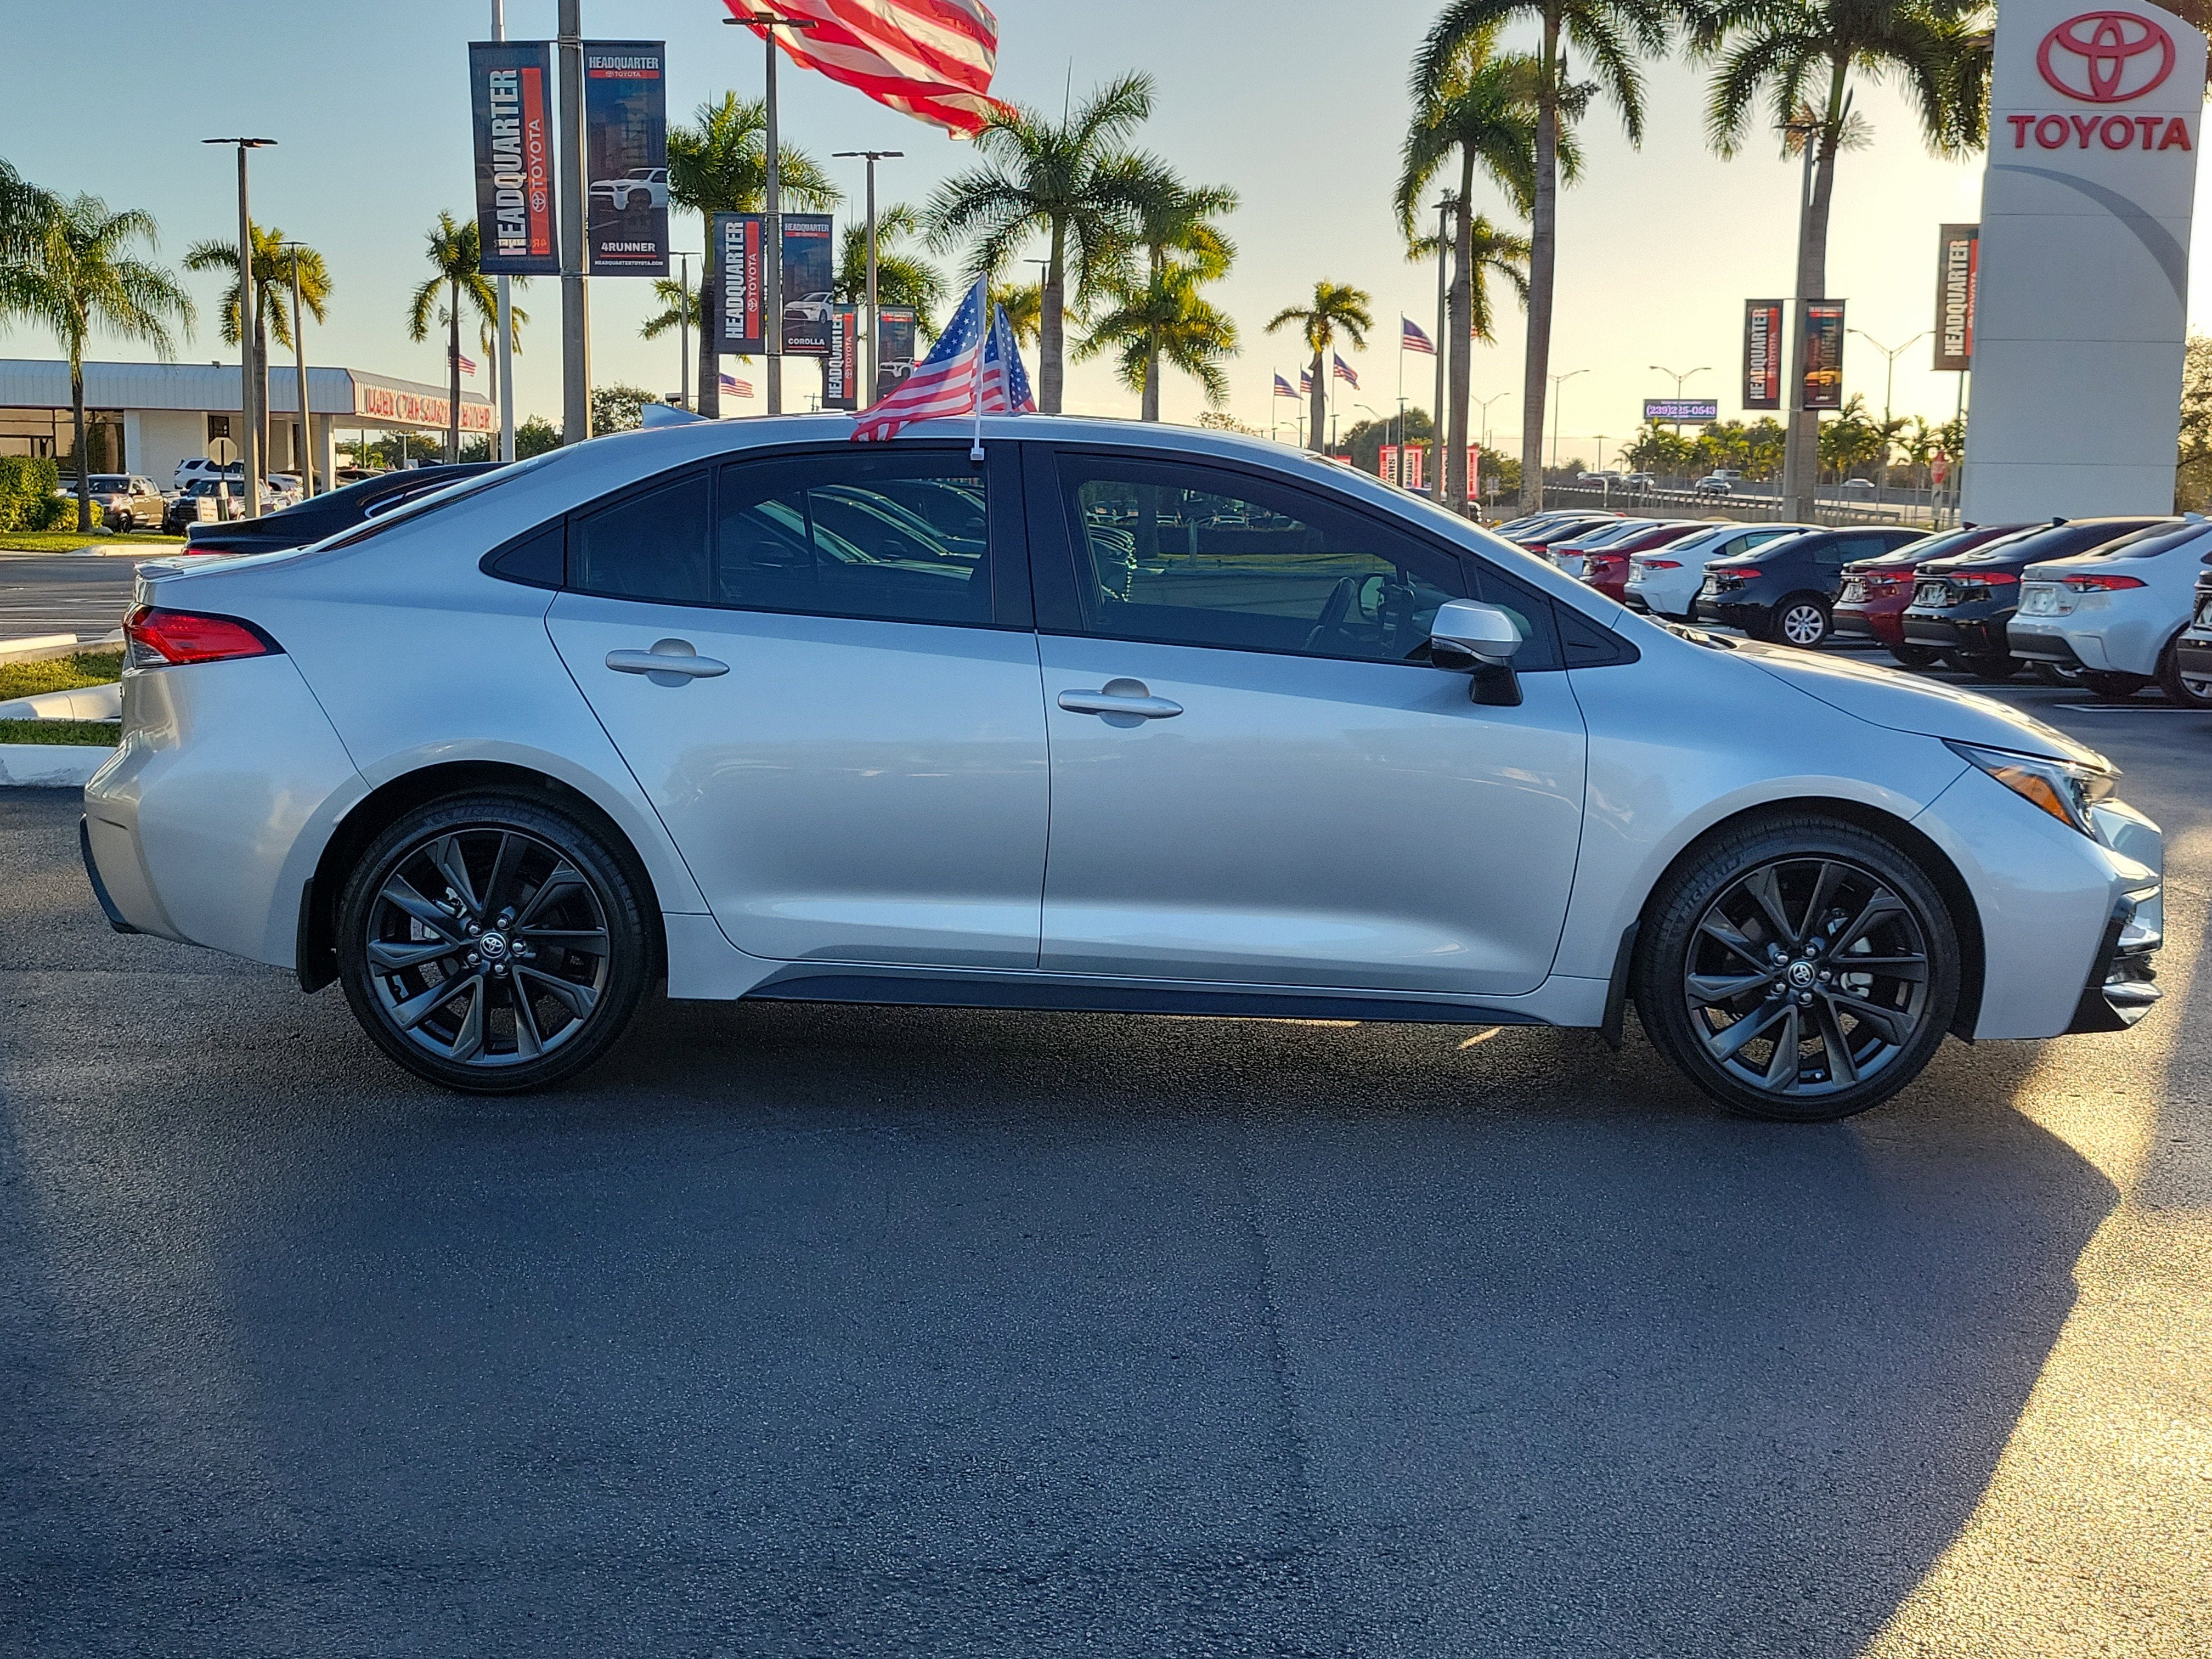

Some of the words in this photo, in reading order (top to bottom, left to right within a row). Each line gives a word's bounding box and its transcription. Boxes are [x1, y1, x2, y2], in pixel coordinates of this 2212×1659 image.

[589, 57, 659, 70] HEADQUARTER
[490, 70, 528, 256] HEADQUARTER
[529, 119, 544, 189] TOYOTA
[2006, 114, 2192, 150] TOYOTA
[601, 242, 656, 252] 4RUNNER
[785, 223, 830, 232] HEADQUARTER
[725, 222, 747, 339] HEADQUARTER
[748, 253, 757, 297] TOYOTA
[1944, 240, 1970, 356] HEADQUARTER
[828, 314, 844, 398] HEADQUARTER
[1750, 308, 1769, 400] HEADQUARTER
